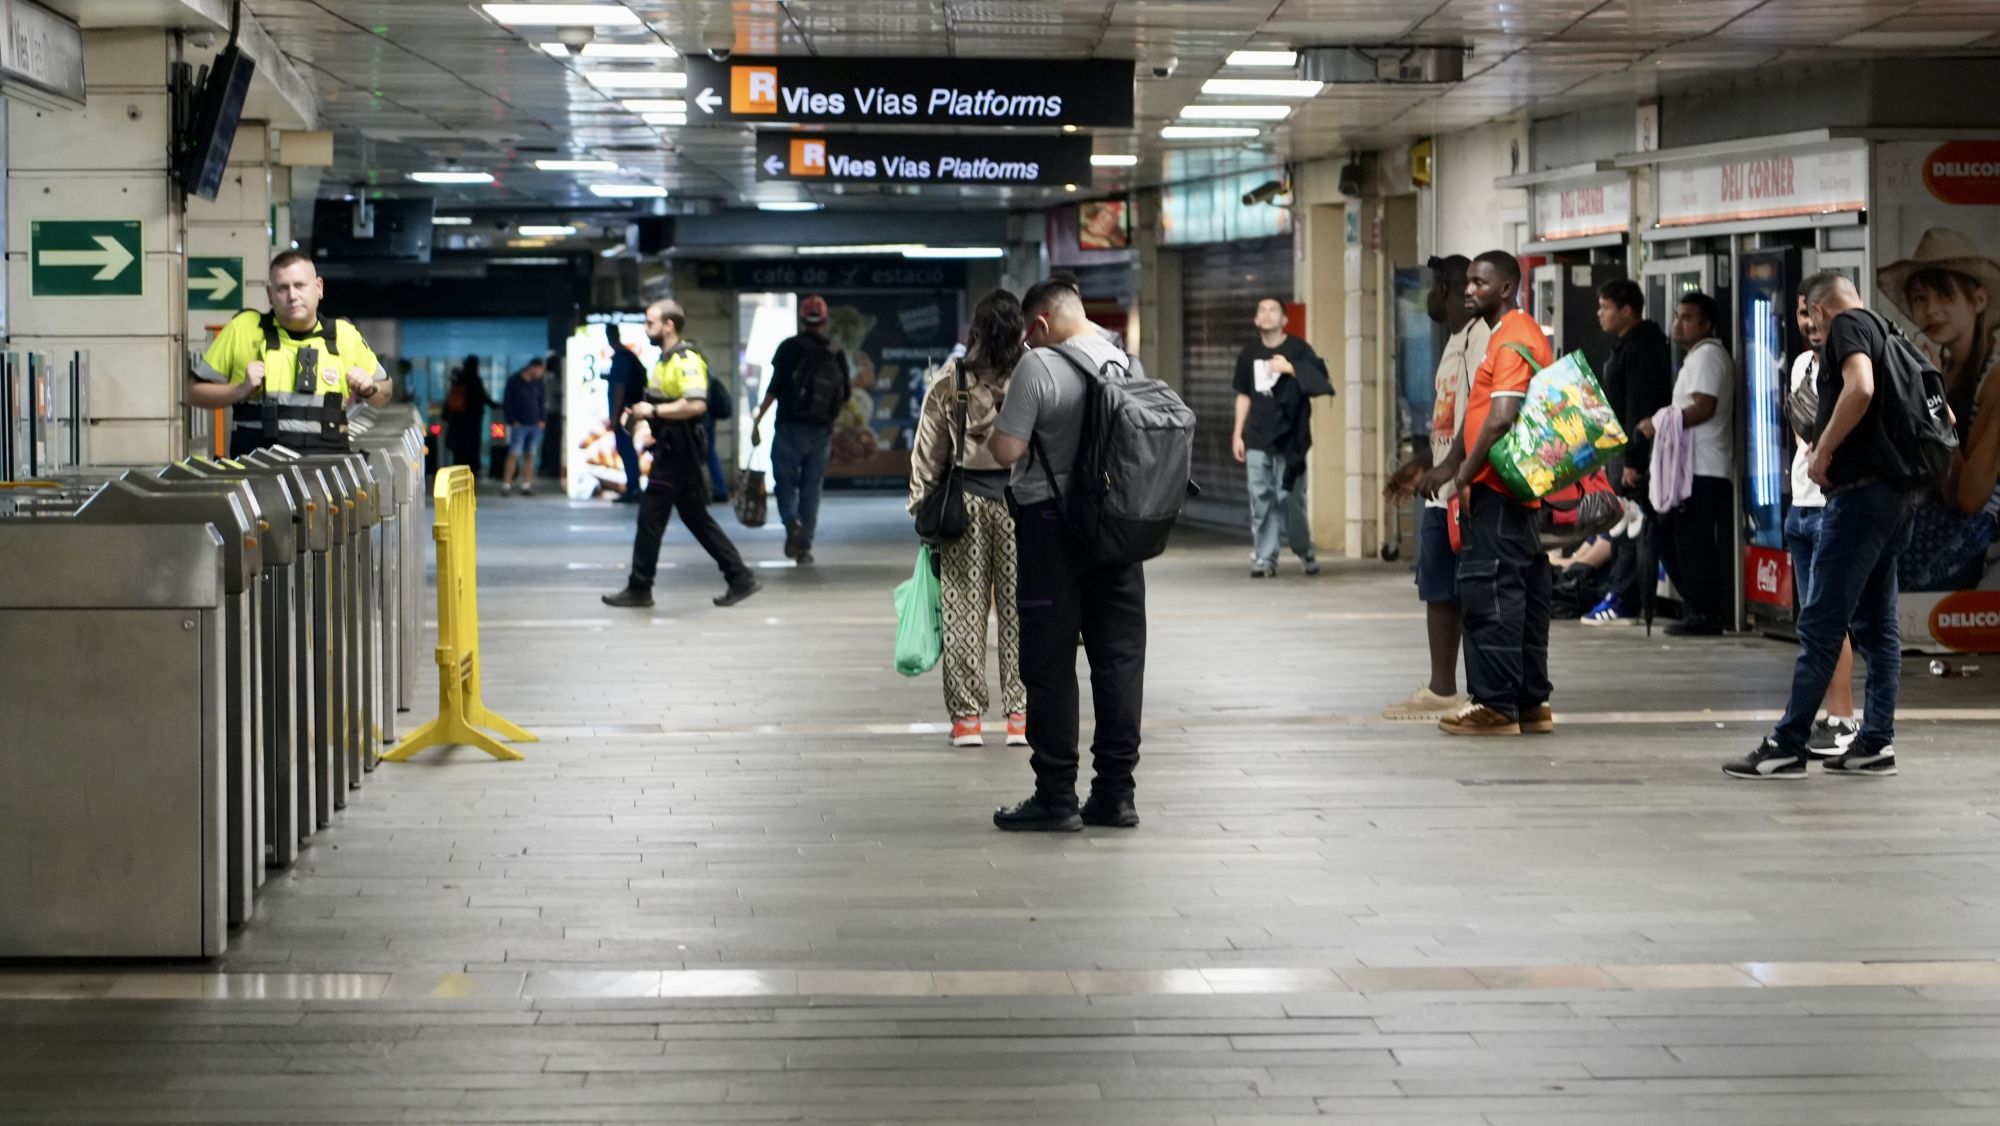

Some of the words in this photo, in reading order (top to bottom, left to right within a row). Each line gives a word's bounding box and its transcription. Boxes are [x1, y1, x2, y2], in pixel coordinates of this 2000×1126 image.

[749, 71, 775, 102] R
[782, 87, 846, 114] Vies
[854, 87, 918, 115] Vías
[928, 89, 1062, 118] Platforms
[803, 143, 825, 167] R
[828, 155, 877, 177] Vies
[882, 155, 931, 178] Vías
[937, 156, 1039, 180] Platforms
[1721, 164, 1744, 202] DELI
[1748, 157, 1795, 200] CORNER
[803, 265, 829, 284] de
[1938, 612, 2000, 629] DELICO
